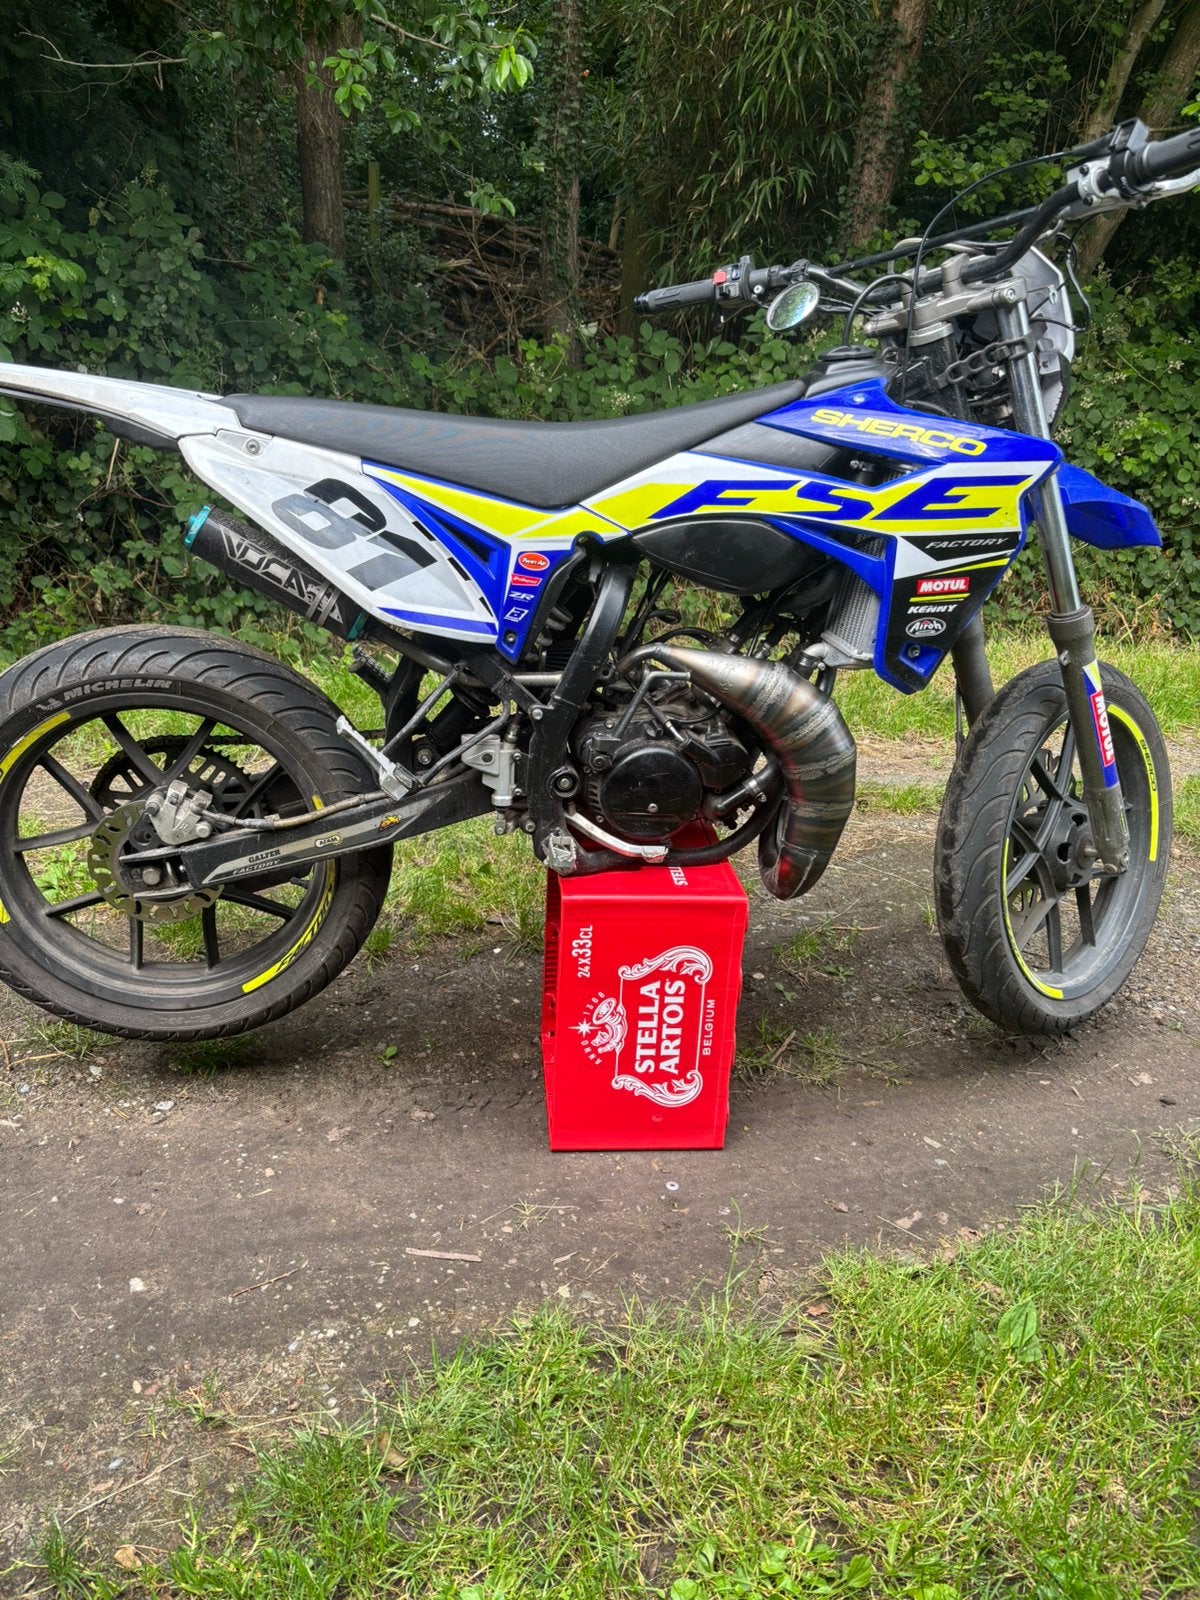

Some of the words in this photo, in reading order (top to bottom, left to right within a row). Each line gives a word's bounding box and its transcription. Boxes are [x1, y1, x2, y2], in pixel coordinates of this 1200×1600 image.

[810, 408, 987, 456] SHERCO
[647, 474, 1034, 520] FSE
[271, 478, 438, 592] 81
[925, 537, 1009, 549] FACTORY
[508, 590, 535, 600] ZR
[919, 579, 967, 593] MOTUL
[907, 604, 958, 614] KENNY
[909, 619, 942, 633] Airoh
[64, 679, 173, 701] MICHELIN
[1094, 695, 1115, 761] MOTUL
[232, 859, 281, 876] FACTORY
[248, 849, 281, 864] GALFER
[668, 866, 689, 886] STEL
[635, 980, 662, 1074] STELLA
[659, 979, 687, 1075] ARTOIS
[702, 999, 716, 1056] BELGIUM
[581, 1040, 602, 1065] ANNO
